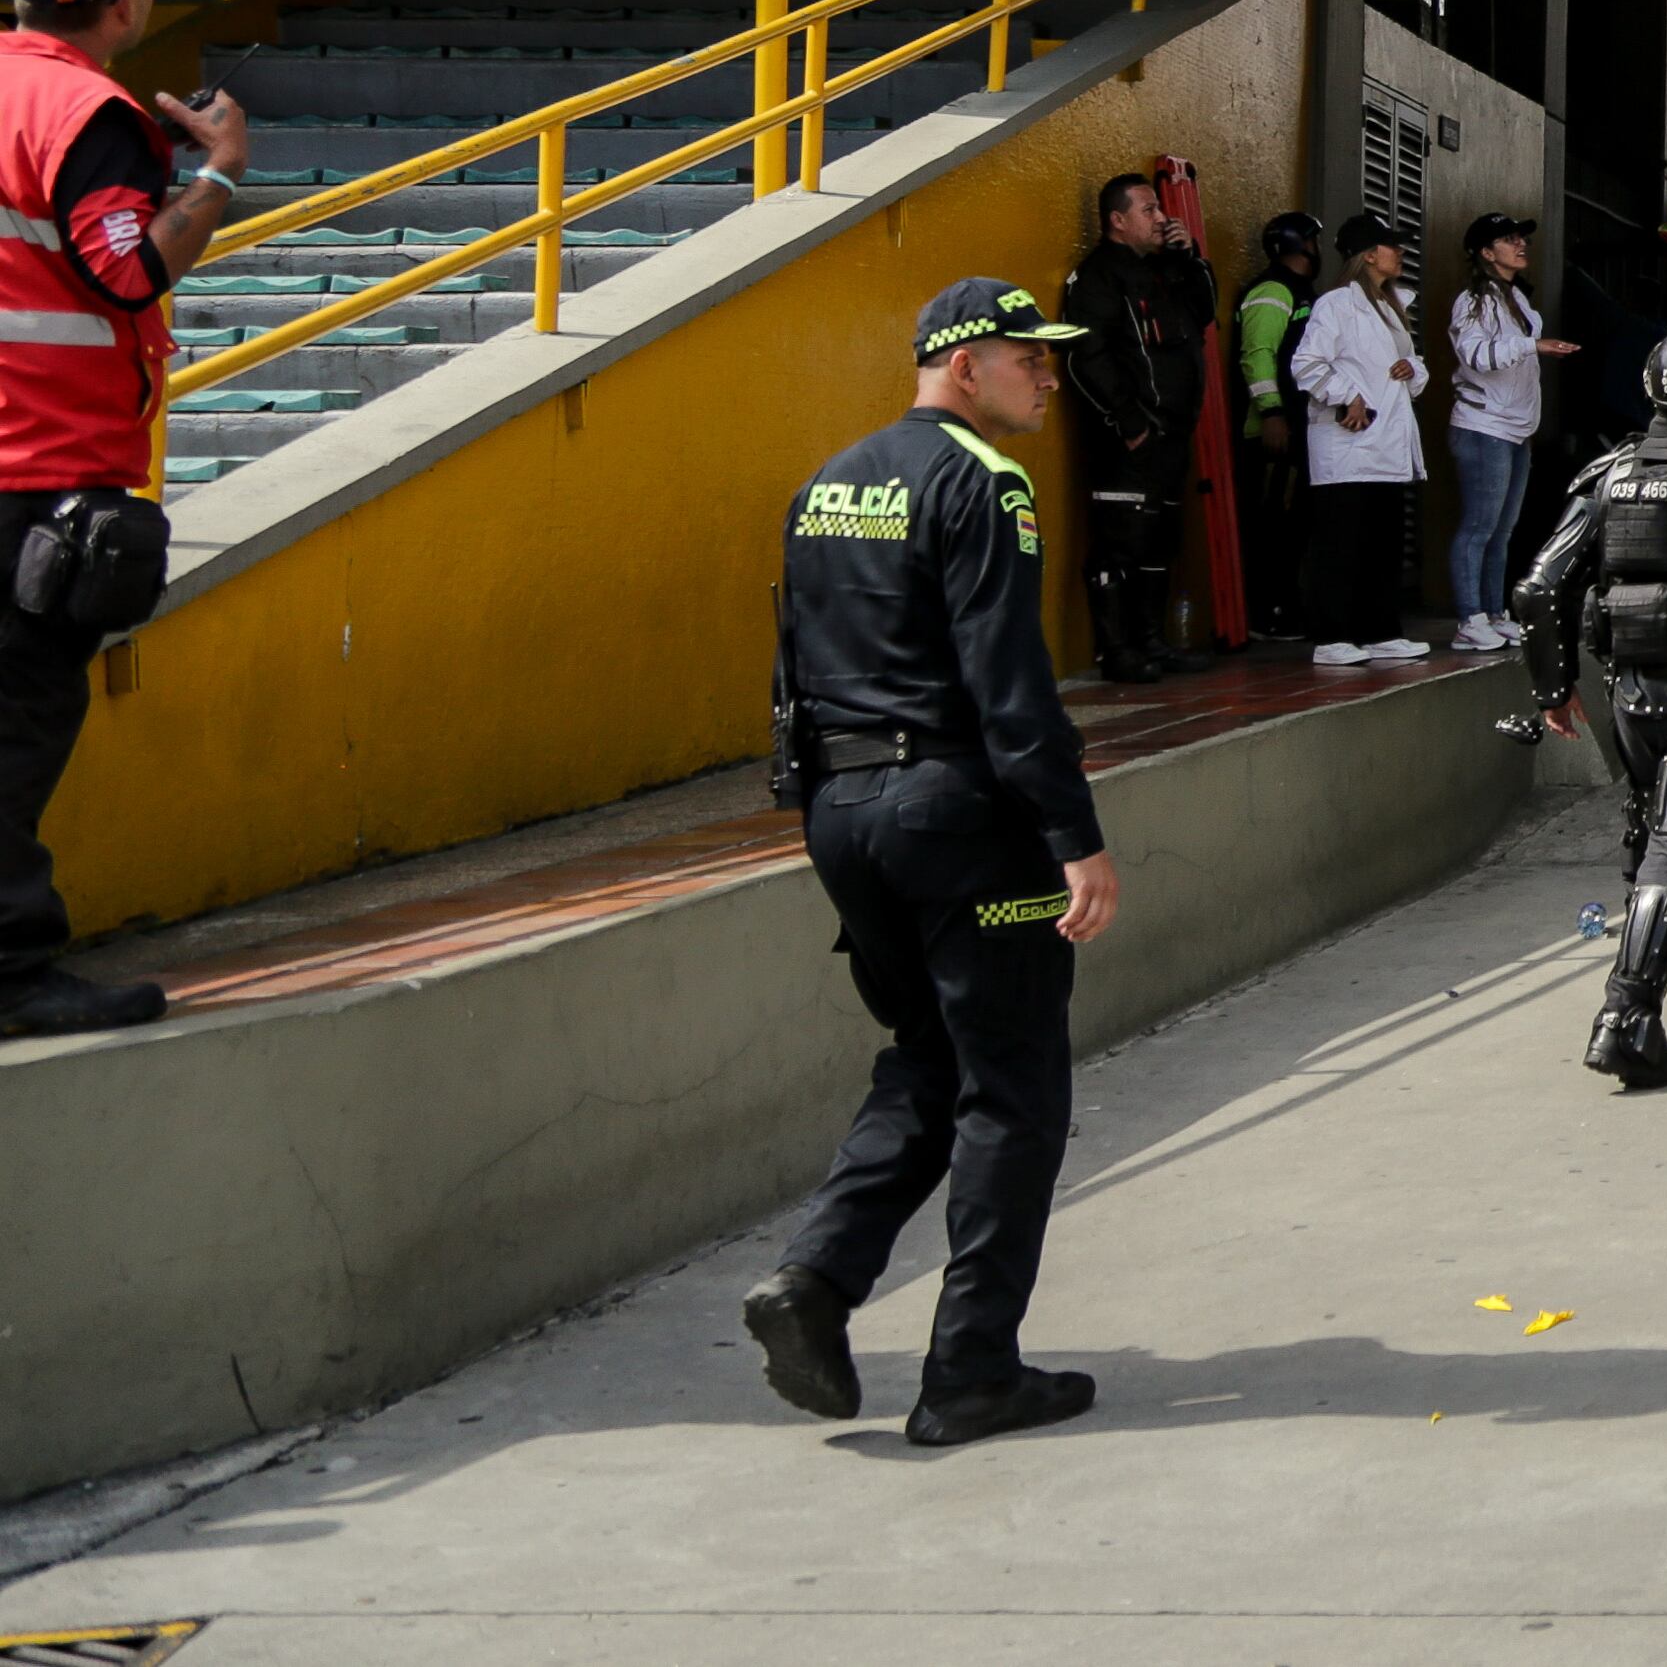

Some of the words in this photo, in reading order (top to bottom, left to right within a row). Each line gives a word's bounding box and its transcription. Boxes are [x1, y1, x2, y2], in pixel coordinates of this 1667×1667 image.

[807, 477, 909, 517] POLICÍA
[1611, 483, 1636, 499] 039
[1641, 482, 1667, 499] 466
